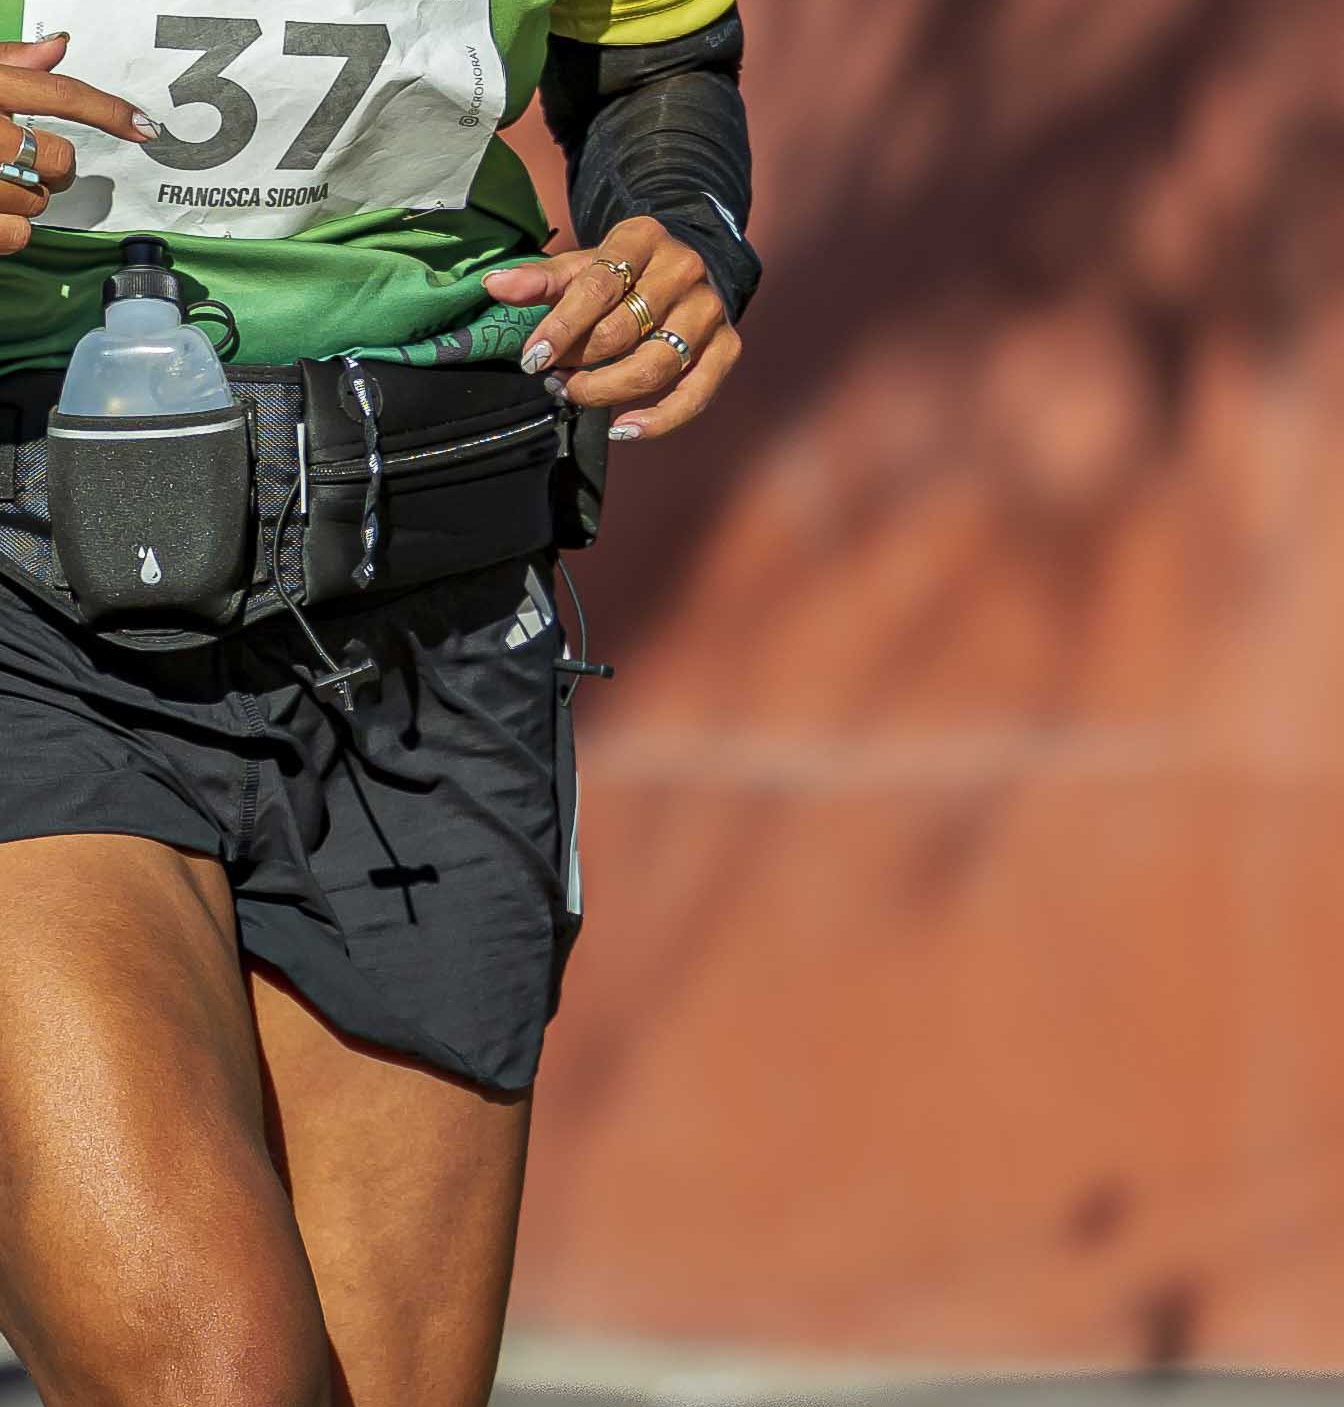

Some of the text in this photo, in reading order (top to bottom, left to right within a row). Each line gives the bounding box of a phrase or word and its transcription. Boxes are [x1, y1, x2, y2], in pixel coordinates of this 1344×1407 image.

[138, 14, 392, 171] 37
[157, 182, 329, 208] FRANCISCA SIBONA
